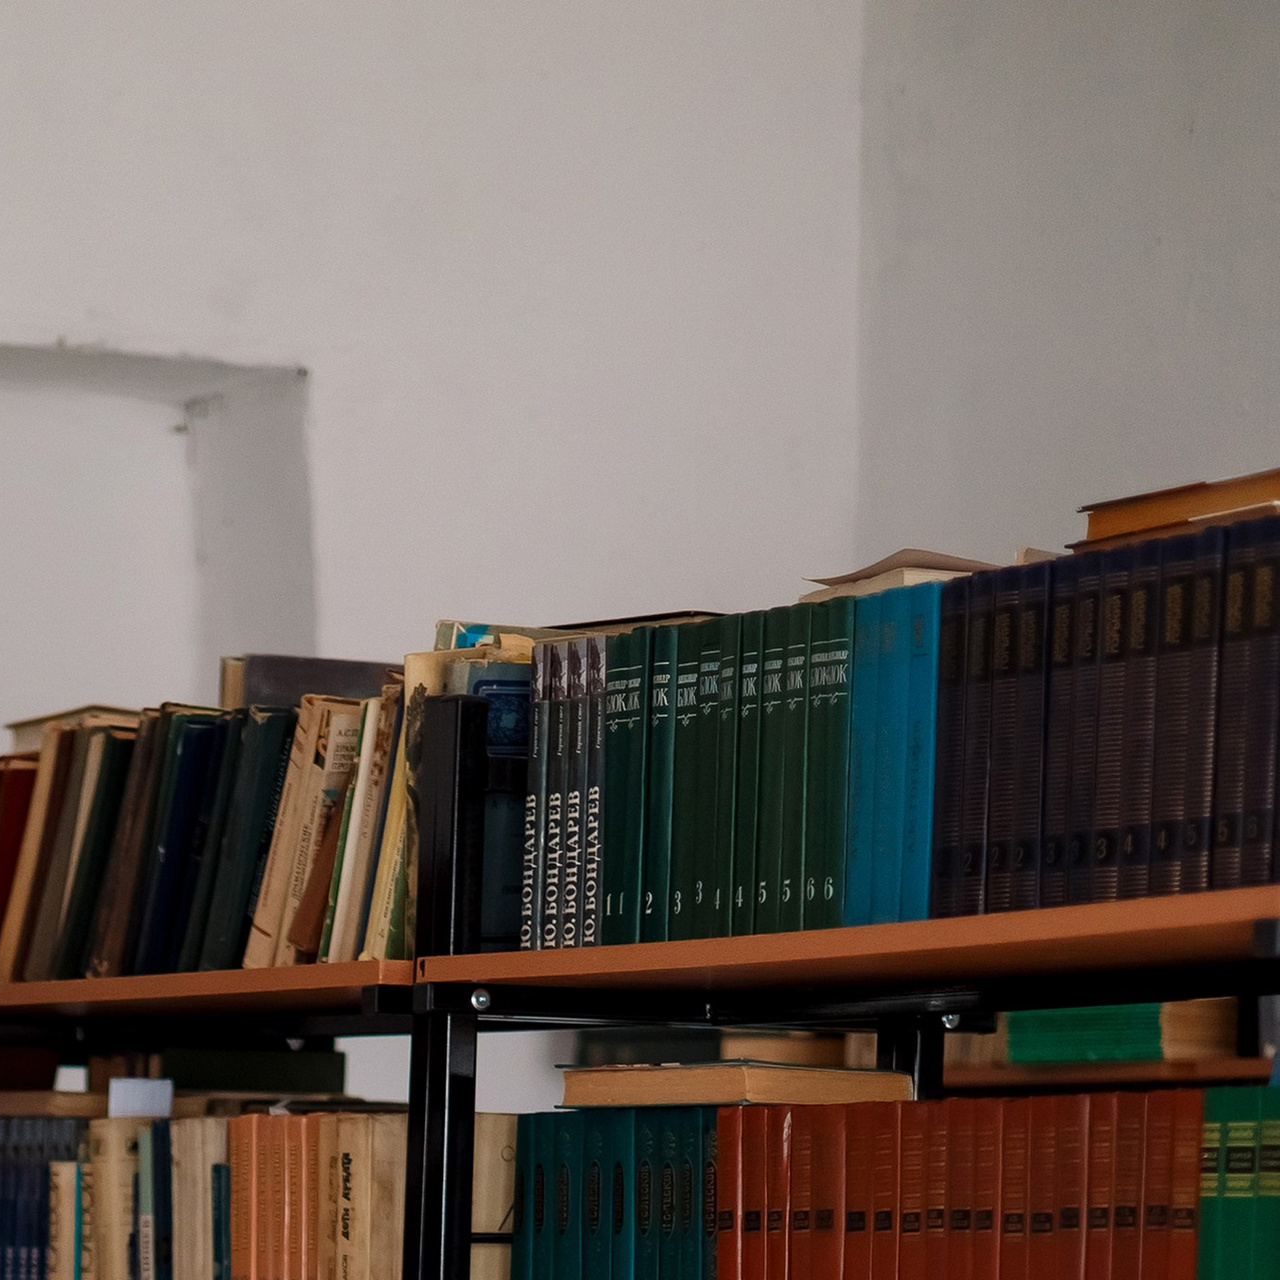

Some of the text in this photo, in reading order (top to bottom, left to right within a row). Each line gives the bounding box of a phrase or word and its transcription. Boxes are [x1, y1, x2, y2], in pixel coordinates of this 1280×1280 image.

[677, 686, 698, 708] БЛОК
[520, 794, 537, 948] Ю. БОНДАРЕВ
[544, 792, 563, 947] Ю. БОНДАРЕВ
[563, 790, 582, 947] Ю. БОНДАРЕВ
[584, 785, 601, 943] Ю. БОНДАРЕВ
[696, 880, 702, 904] 3
[736, 886, 743, 907] 4
[758, 881, 766, 903] 5
[782, 879, 790, 902] 5
[807, 877, 815, 900] 6
[824, 877, 834, 900] 6
[606, 893, 612, 916] 1
[645, 891, 653, 914] 2
[674, 891, 681, 914] 3
